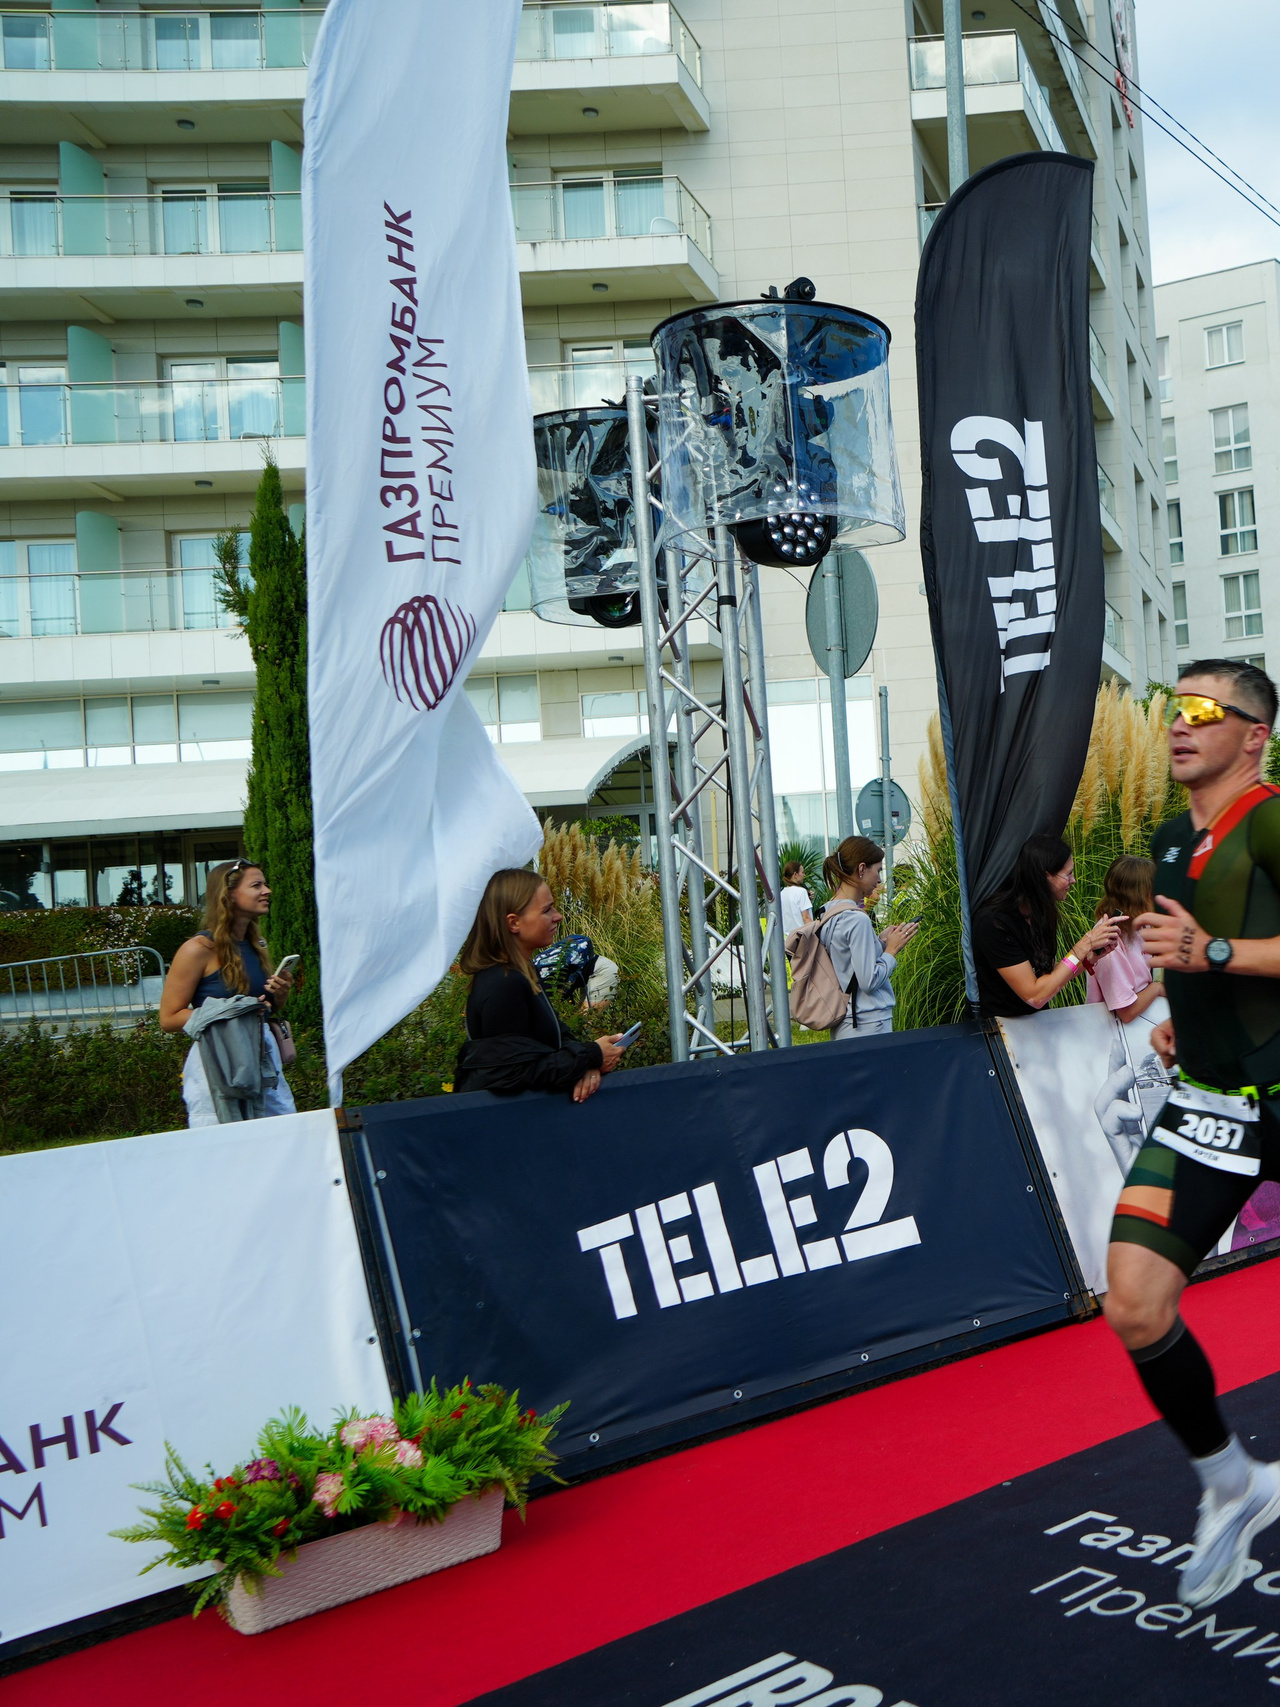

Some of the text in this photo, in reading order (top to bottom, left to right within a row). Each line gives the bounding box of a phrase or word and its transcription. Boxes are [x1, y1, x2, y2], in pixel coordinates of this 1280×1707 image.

[380, 200, 425, 563] ГАЗПРОМБАНК
[412, 335, 461, 565] ПРЕМИУМ
[950, 415, 1057, 694] TELE2
[577, 1128, 922, 1320] TELE2
[1176, 1113, 1245, 1150] 2037
